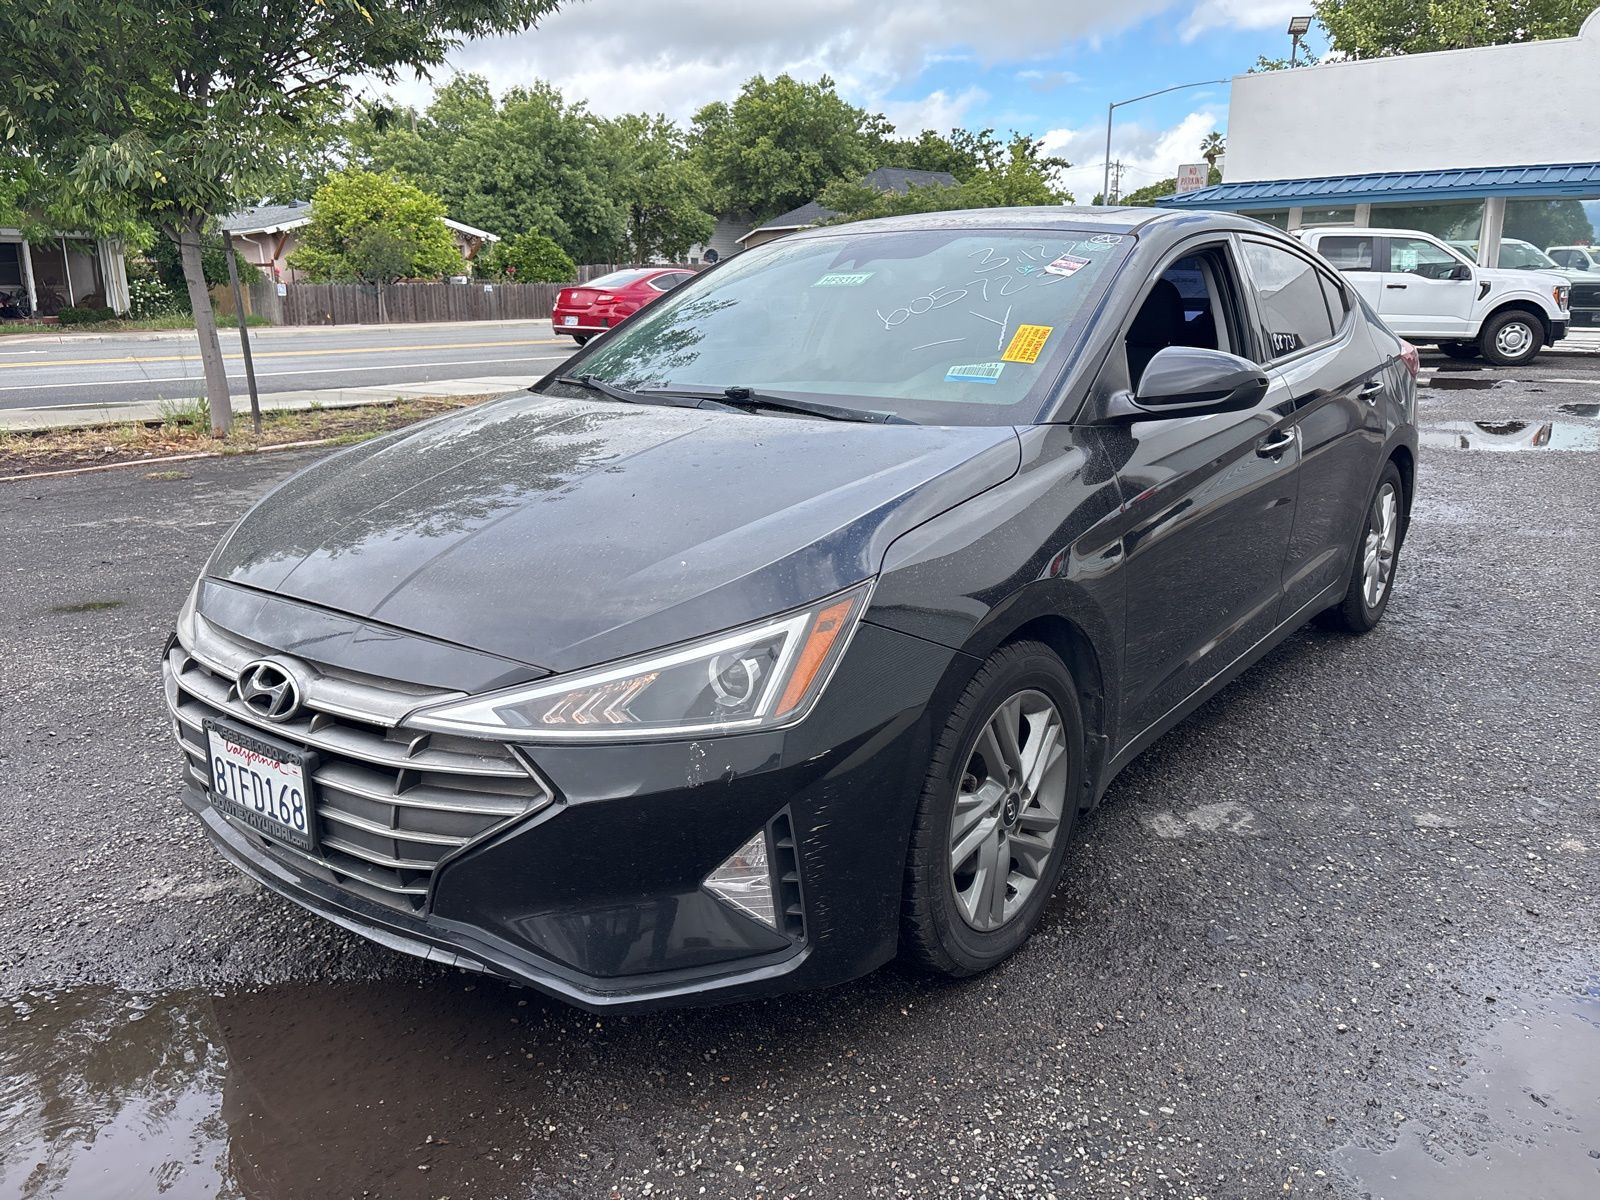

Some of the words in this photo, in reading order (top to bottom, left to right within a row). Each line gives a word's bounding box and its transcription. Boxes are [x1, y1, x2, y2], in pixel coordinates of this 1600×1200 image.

[1189, 167, 1197, 175] NO
[1180, 176, 1204, 186] PARKING
[1018, 347, 1030, 360] SALE
[1025, 340, 1043, 362] VEHICLE
[224, 740, 289, 775] California
[214, 756, 304, 831] 8TFD168
